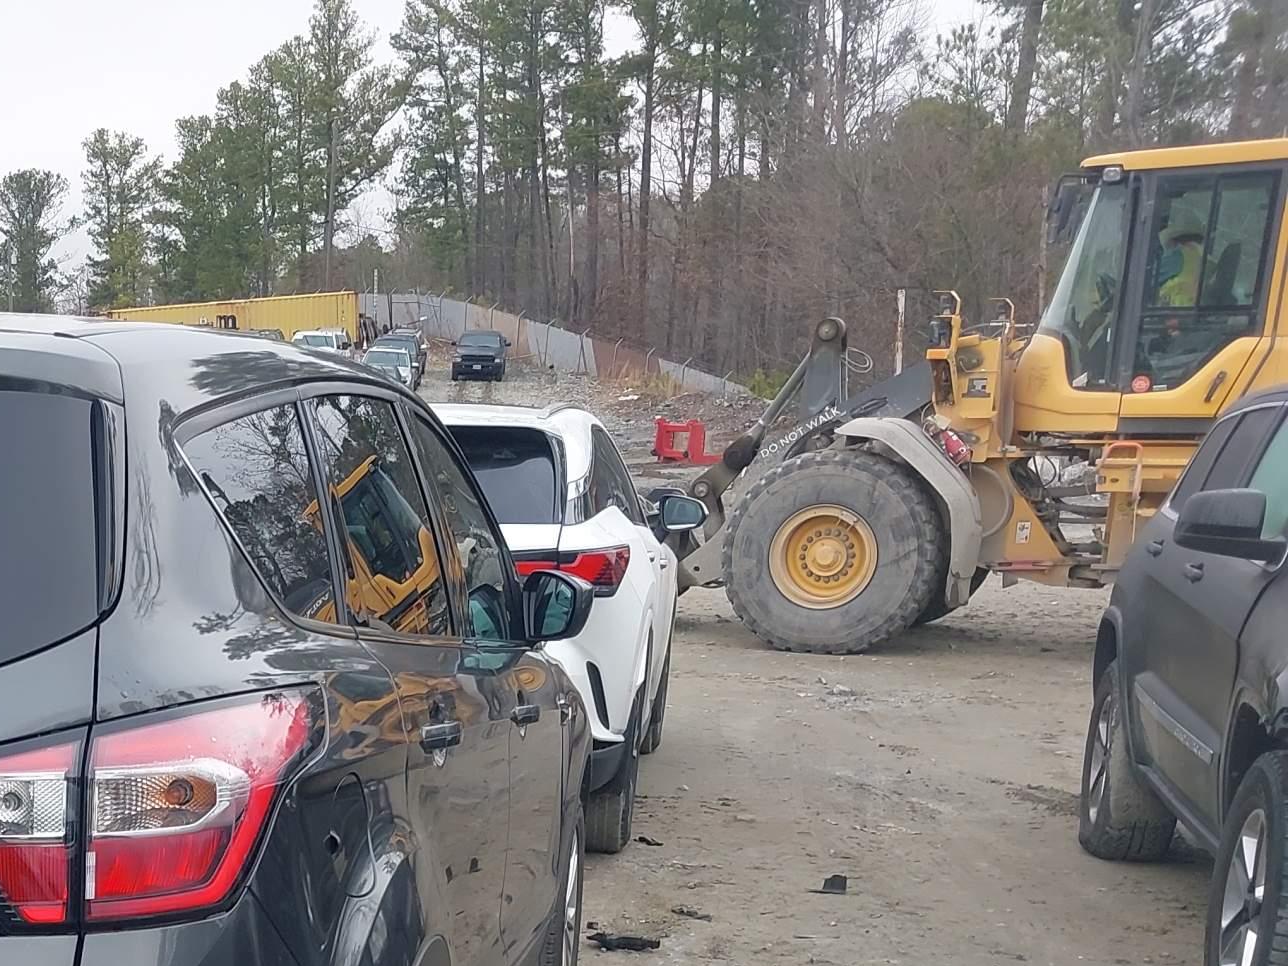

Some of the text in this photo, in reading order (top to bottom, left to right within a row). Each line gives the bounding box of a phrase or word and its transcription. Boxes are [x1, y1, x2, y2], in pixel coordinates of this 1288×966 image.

[760, 406, 842, 458] DO NOT WALK
